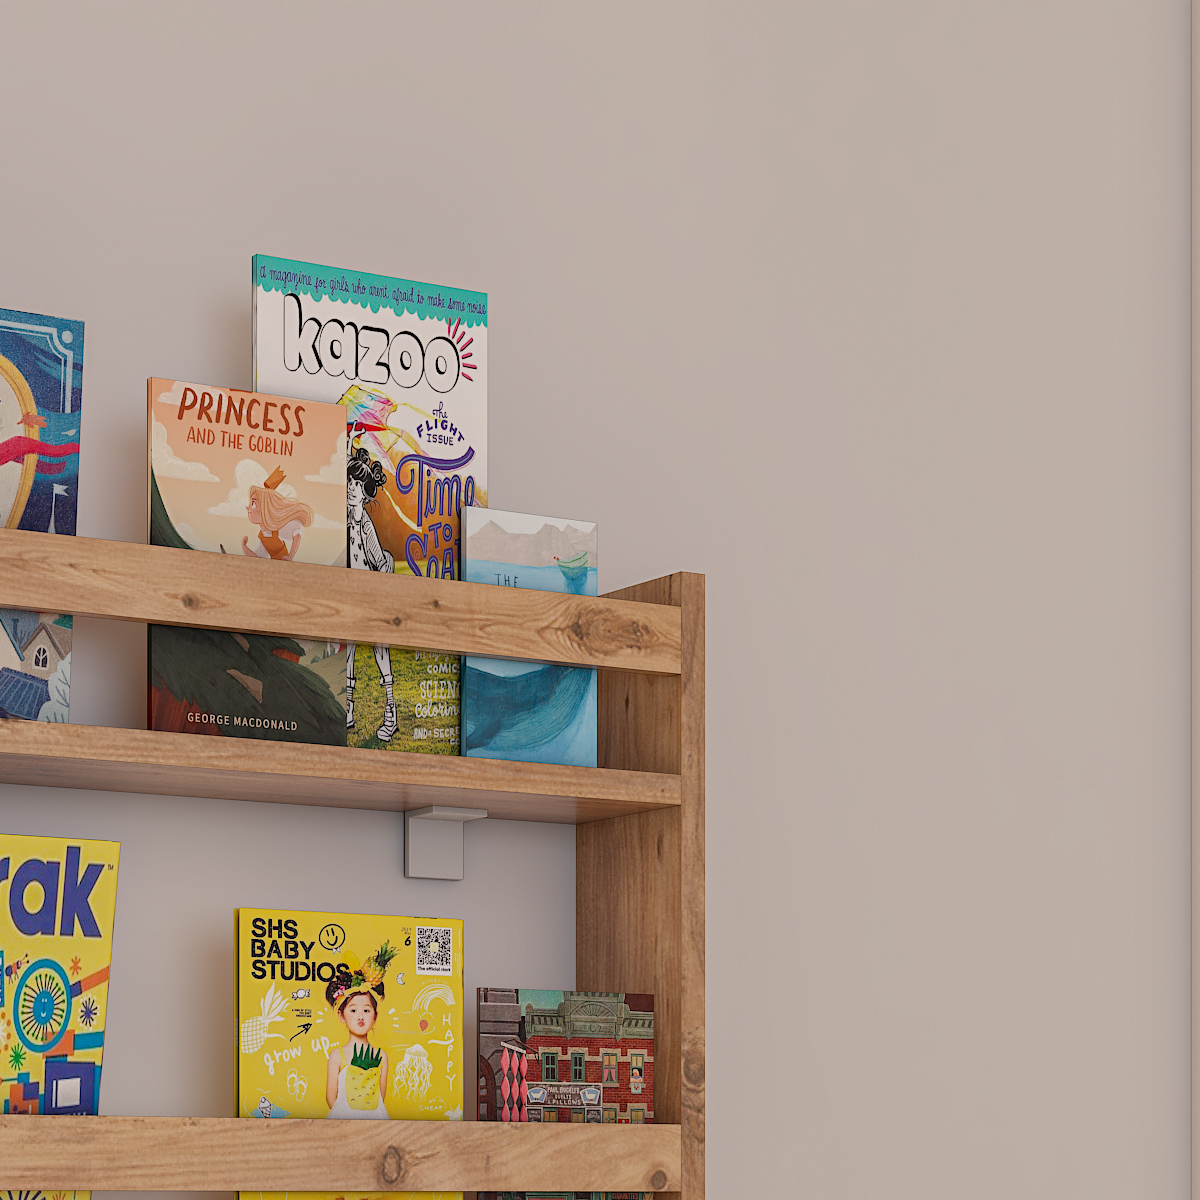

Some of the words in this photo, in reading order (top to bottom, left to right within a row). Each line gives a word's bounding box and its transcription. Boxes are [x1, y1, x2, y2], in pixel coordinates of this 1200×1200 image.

[314, 277, 326, 293] for
[330, 276, 349, 295] girls
[351, 278, 366, 295] who
[392, 287, 414, 306] afraid
[417, 290, 424, 305] to
[427, 293, 445, 308] make
[447, 297, 465, 312] some
[467, 301, 486, 315] noise
[283, 292, 460, 393] kazoo
[177, 387, 305, 437] PRINCESS
[187, 426, 215, 445] AND
[221, 430, 244, 450] THE
[249, 434, 293, 457] GOBLIN
[416, 419, 465, 443] FLIGHT
[427, 433, 454, 446] ISSUE
[428, 522, 453, 549] TO
[494, 573, 518, 588] THE
[187, 712, 230, 725] GEORGE
[233, 716, 298, 731] MACDONALD
[251, 918, 298, 939] SHS
[404, 935, 412, 946] 6
[251, 938, 315, 960] BABY
[251, 959, 350, 982] STUDIOS
[264, 1046, 302, 1076] grow
[442, 1012, 456, 1092] HAPPY
